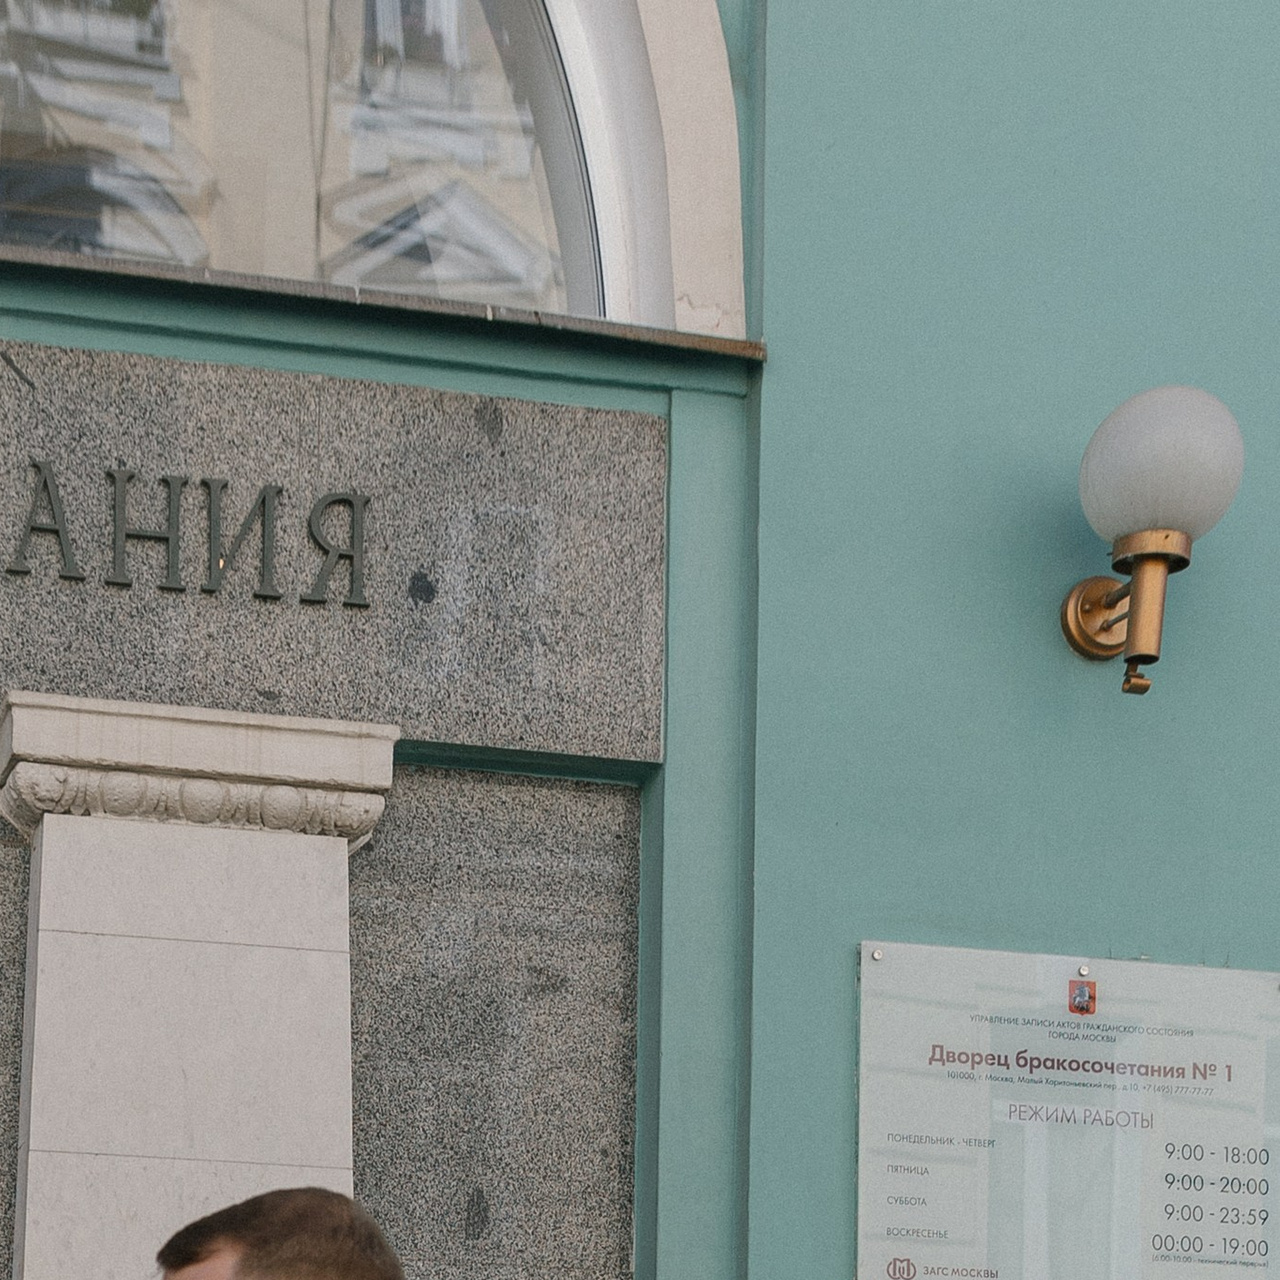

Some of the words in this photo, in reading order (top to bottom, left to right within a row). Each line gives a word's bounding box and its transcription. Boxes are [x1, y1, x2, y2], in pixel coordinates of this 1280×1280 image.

[970, 1014, 1019, 1026] УПРАВЛЕНИЕ
[1021, 1018, 1055, 1029] ЗАПИСИ
[1056, 1021, 1081, 1031] АКТОВ
[1083, 1023, 1144, 1034] ГРАЖДАНСКОГО
[1146, 1027, 1194, 1037] СОСТОЯНИЯ
[1048, 1031, 1080, 1041] ГОРОДА
[1081, 1033, 1117, 1043] МОСКВЫ
[928, 1044, 1010, 1071] Дворец
[1015, 1049, 1186, 1080] бракосочетания
[1192, 1062, 1217, 1081] №
[1225, 1065, 1232, 1082] 1
[1008, 1103, 1077, 1125] РЕЖИМ
[1083, 1108, 1154, 1130] РАБОТЫ
[887, 1133, 955, 1146] ПОНЕДЕЛЬНИК
[962, 1137, 996, 1149] ЧЕТВЕРГ
[1165, 1142, 1204, 1162] 9:00
[1224, 1146, 1269, 1166] 18:00
[887, 1164, 930, 1176] ПЯТНИЦА
[1164, 1173, 1204, 1192] 9:00
[1220, 1176, 1269, 1196] 20:00
[886, 1195, 928, 1207] СУББОТА
[1164, 1203, 1204, 1222] 9:00
[1219, 1206, 1269, 1226] 23:59
[886, 1227, 949, 1239] ВОСКРЕСЕНЬЕ
[1151, 1233, 1203, 1253] 00:00
[1222, 1237, 1269, 1257] 19:00
[923, 1265, 949, 1277] ЗАГС
[951, 1267, 999, 1279] МОСКВЫ
